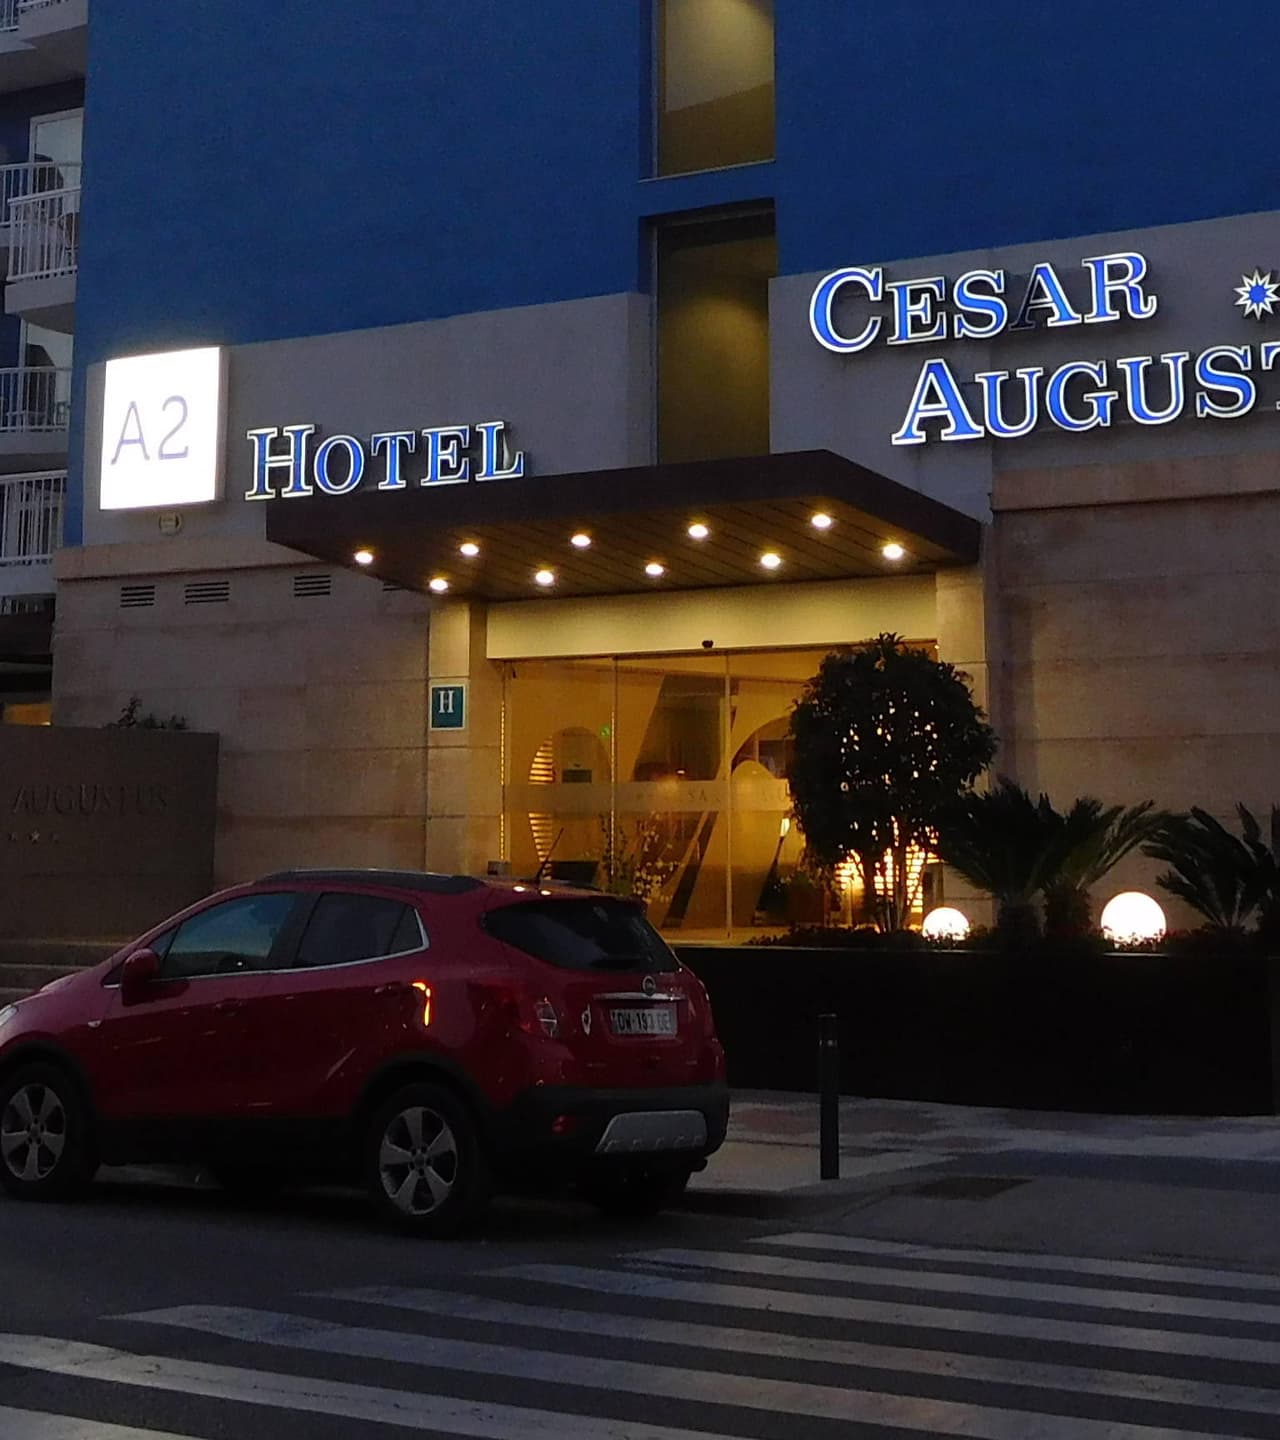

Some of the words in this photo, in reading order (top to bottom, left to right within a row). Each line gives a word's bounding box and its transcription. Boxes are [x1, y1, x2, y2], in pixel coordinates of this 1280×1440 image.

[808, 251, 1158, 354] CESAR
[111, 394, 190, 466] A2
[244, 420, 526, 502] HOTEL
[438, 689, 456, 714] H
[12, 782, 169, 815] AUGUSTUS
